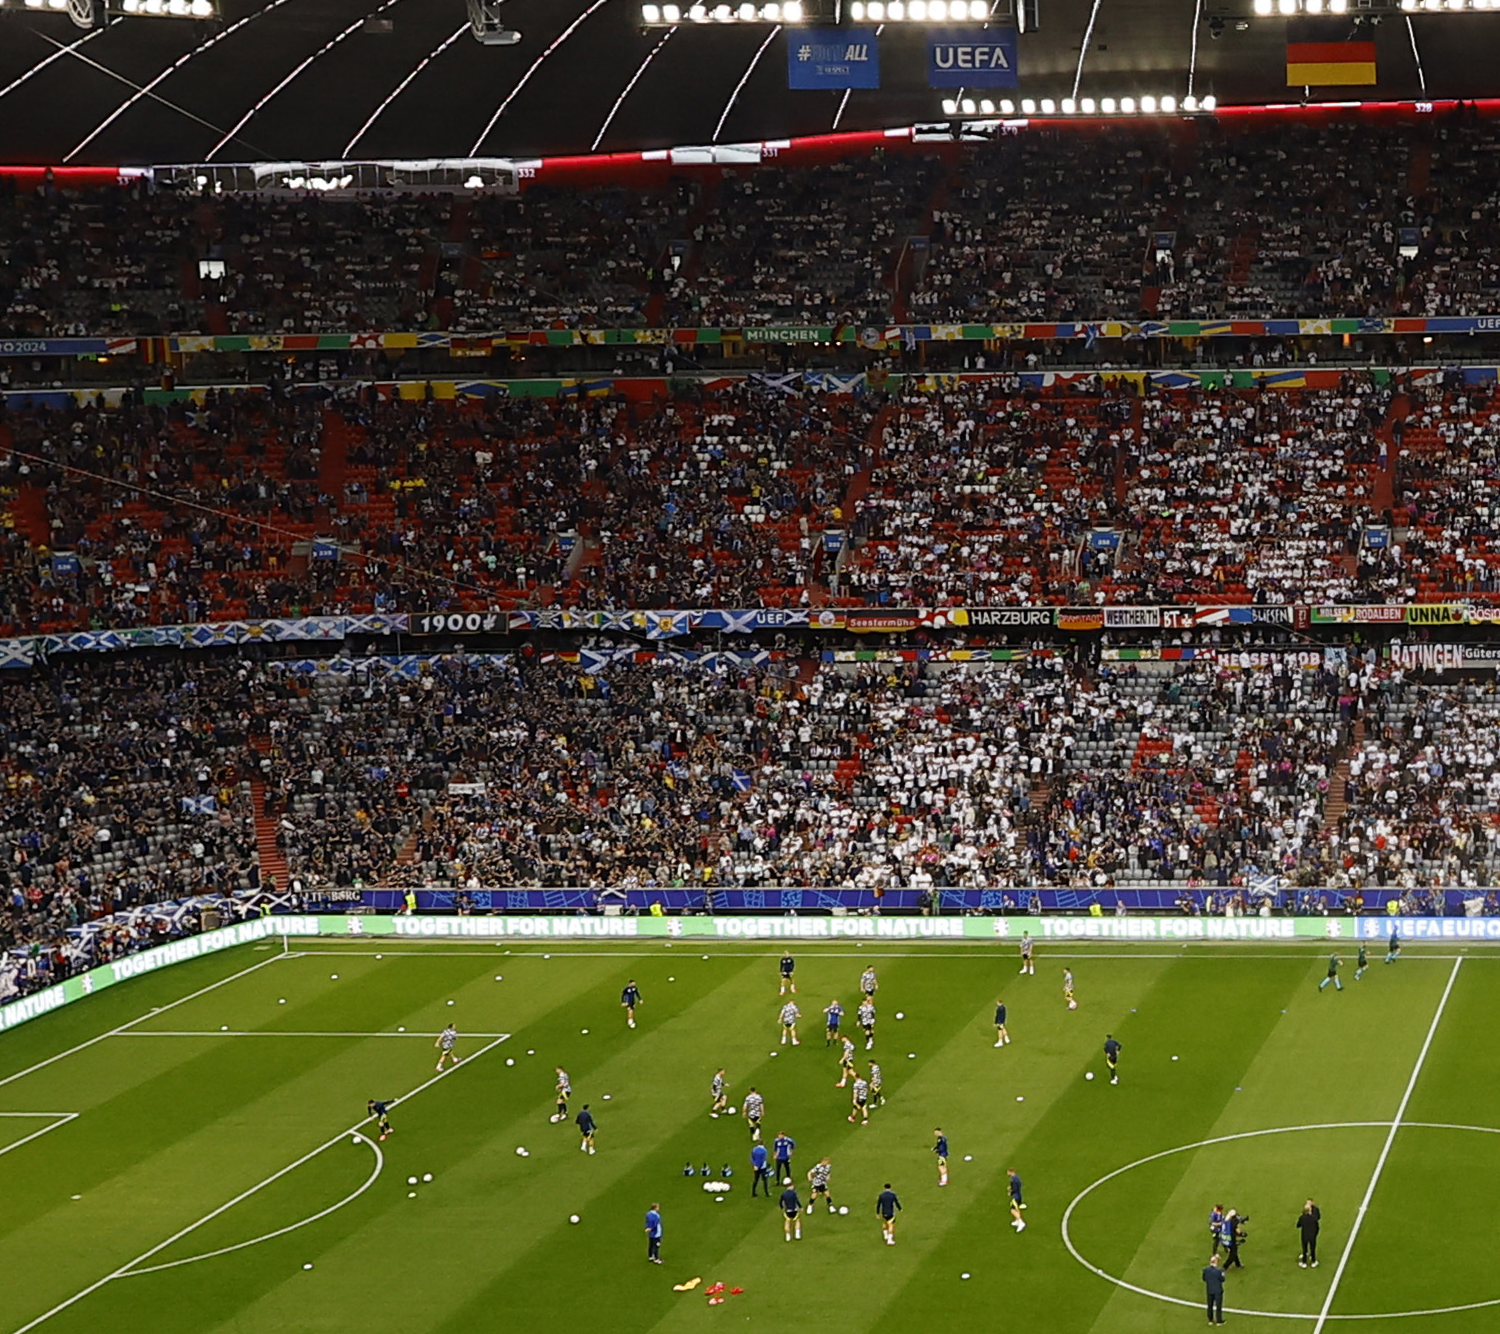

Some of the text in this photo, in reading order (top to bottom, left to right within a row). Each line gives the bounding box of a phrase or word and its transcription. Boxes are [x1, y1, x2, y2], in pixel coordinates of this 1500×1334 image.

[935, 46, 1009, 69] UEFA
[761, 147, 779, 158] 331
[518, 168, 536, 179] 332
[747, 328, 819, 341] MÜNCHEN
[968, 611, 1050, 625] HARZBURG
[1355, 607, 1402, 620] RODALBEN
[1408, 609, 1450, 623] UNNA
[420, 614, 482, 633] 1900
[1391, 644, 1463, 669] RATINGEN
[393, 917, 637, 934] TOGETHER FOR NATURE
[713, 917, 964, 935] TOGETHER FOR NATURE
[1040, 918, 1295, 936] TOGETHER FOR NATURE
[111, 916, 319, 981] TOGETHER FOR NATURE
[4, 985, 65, 1033] NATURE
